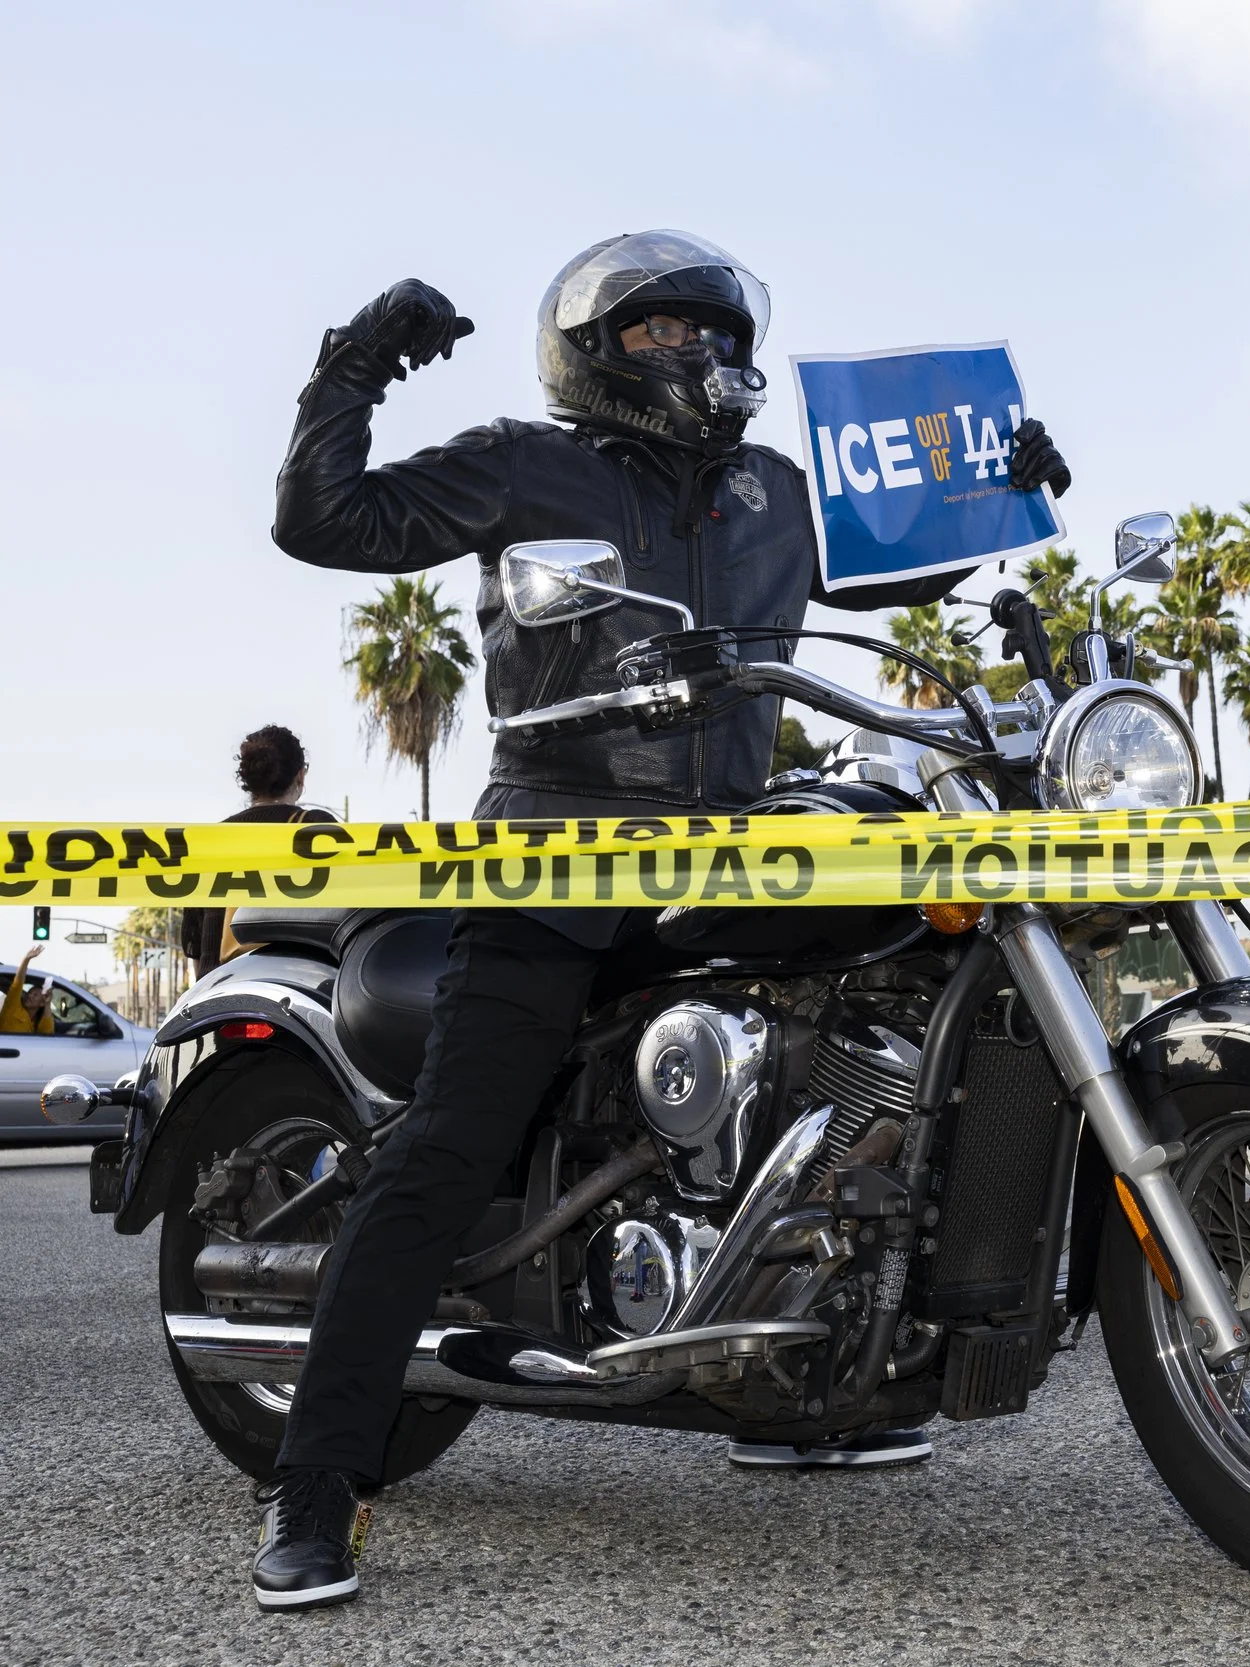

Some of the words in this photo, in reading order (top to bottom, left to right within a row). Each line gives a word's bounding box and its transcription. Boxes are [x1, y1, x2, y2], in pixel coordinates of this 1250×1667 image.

[590, 361, 642, 381] SCORPION
[558, 366, 670, 434] California
[915, 412, 951, 448] OUT
[817, 418, 923, 496] ICE
[930, 448, 952, 482] OF
[358, 1511, 369, 1536] GEAR
